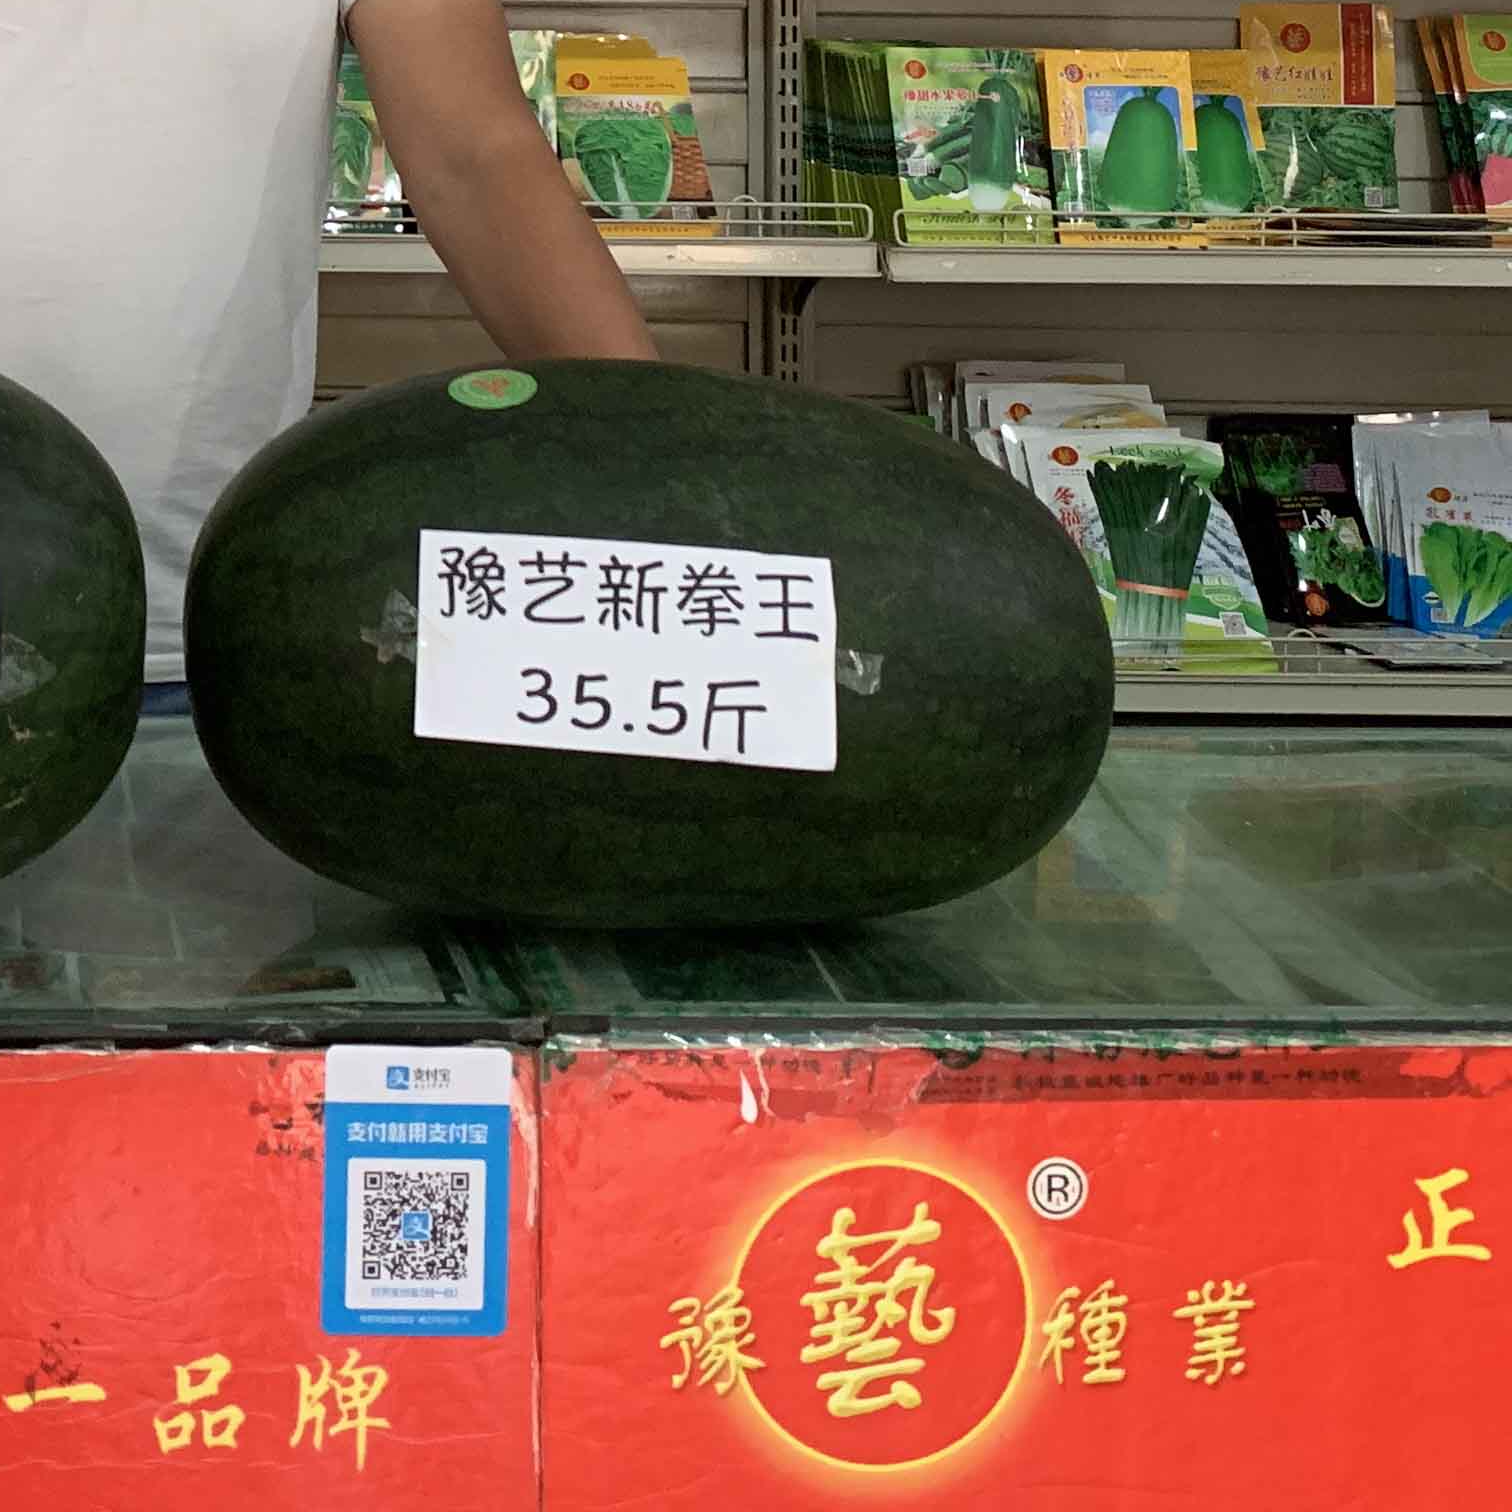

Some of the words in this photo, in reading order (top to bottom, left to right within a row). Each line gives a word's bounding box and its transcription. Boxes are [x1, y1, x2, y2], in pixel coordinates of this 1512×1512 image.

[437, 545, 819, 643] 豫艺新拳王
[516, 667, 767, 755] 35.5斤
[1387, 1167, 1492, 1269] 正
